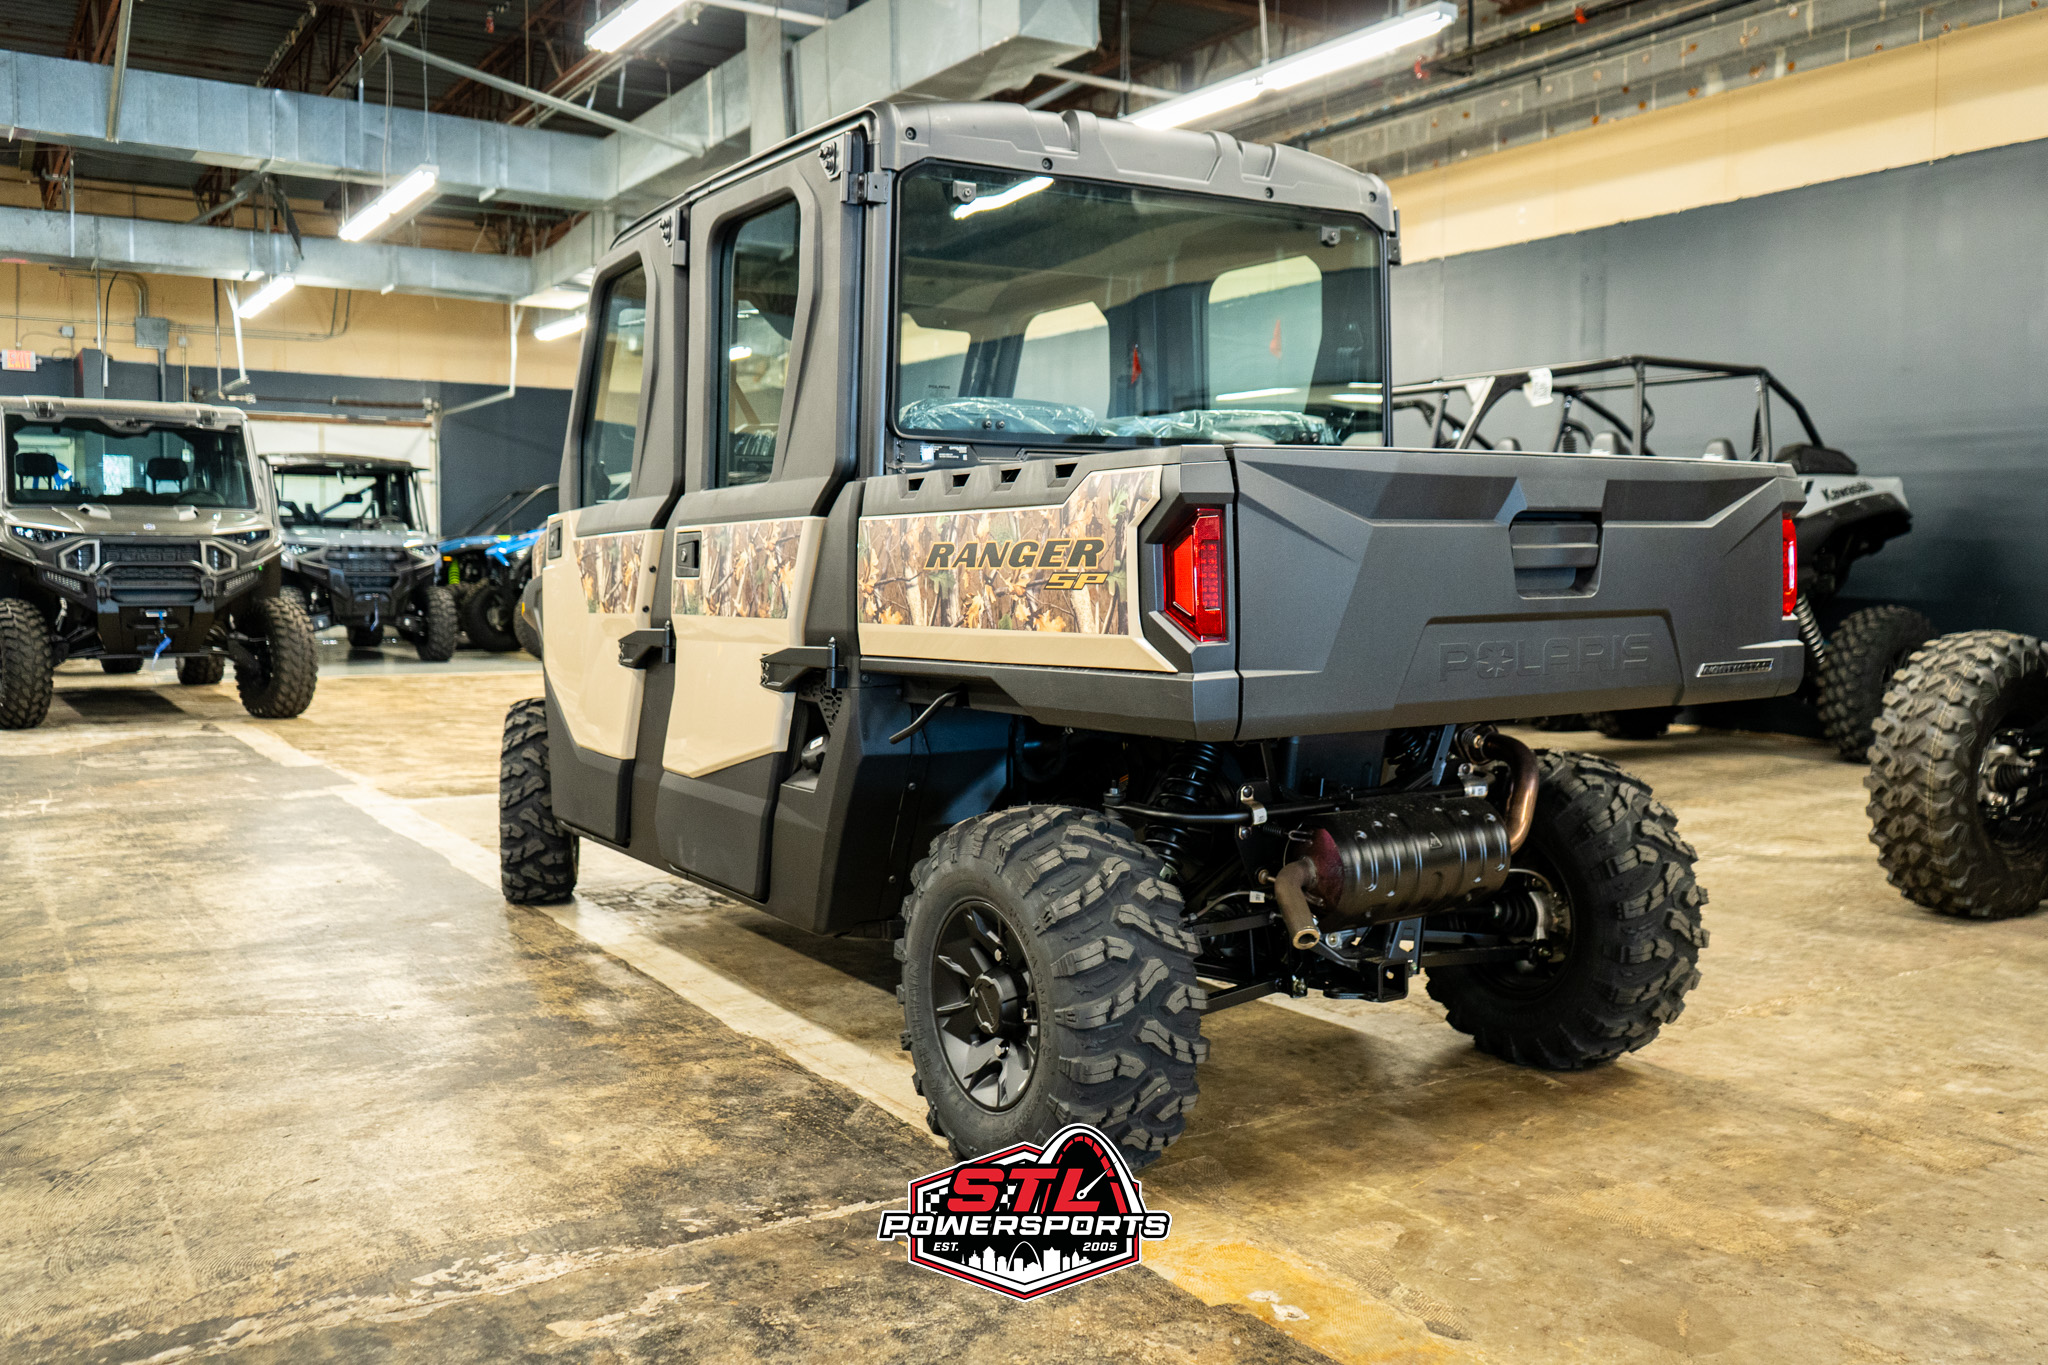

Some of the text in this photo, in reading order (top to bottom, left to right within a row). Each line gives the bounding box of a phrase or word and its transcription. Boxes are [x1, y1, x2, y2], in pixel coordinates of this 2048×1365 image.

[7, 350, 32, 369] EXIT
[923, 537, 1106, 569] RANGER
[1044, 572, 1109, 590] SP
[1438, 633, 1652, 682] POLARIS
